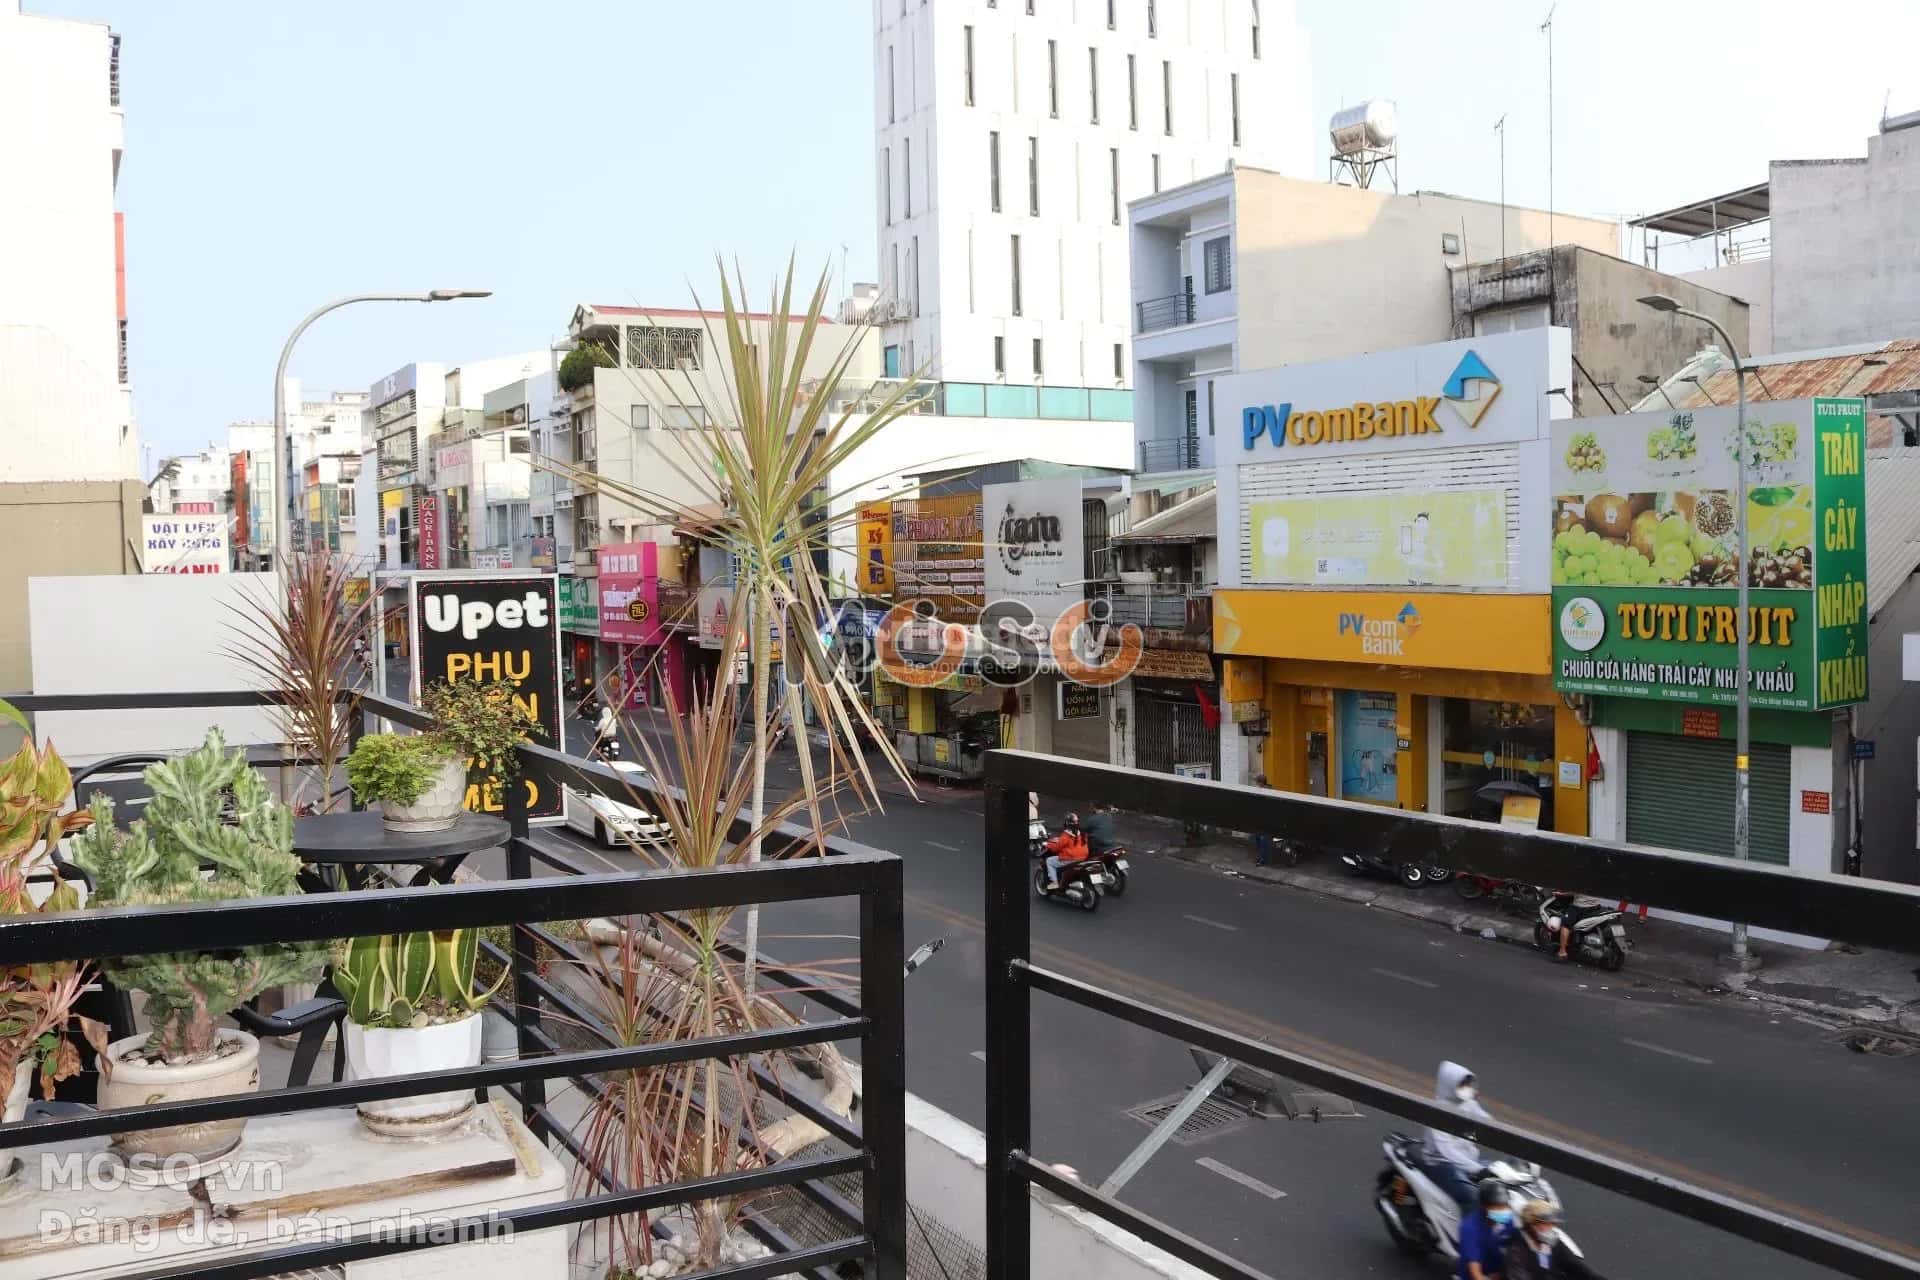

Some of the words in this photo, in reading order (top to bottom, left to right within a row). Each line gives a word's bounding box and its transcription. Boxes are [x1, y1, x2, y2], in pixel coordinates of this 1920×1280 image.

[1242, 396, 1444, 450] PVcomBank
[1821, 424, 1859, 476] TRÁI
[423, 511, 437, 569] AGRIBANK
[1824, 499, 1857, 552] CÂY
[425, 591, 548, 640] Upet
[1618, 603, 1689, 642] TUTI
[1695, 605, 1795, 646] FRUIT
[1818, 573, 1864, 634] NHẬP
[447, 650, 530, 687] PHỤ
[1363, 637, 1405, 656] Bank
[1562, 653, 1594, 678] CHUỖI
[1596, 653, 1620, 680] CỬA
[1657, 659, 1685, 685] TRÁI
[1689, 661, 1712, 687] CÂY
[1756, 661, 1795, 692] KHẨU
[1819, 639, 1866, 704] KHẨU
